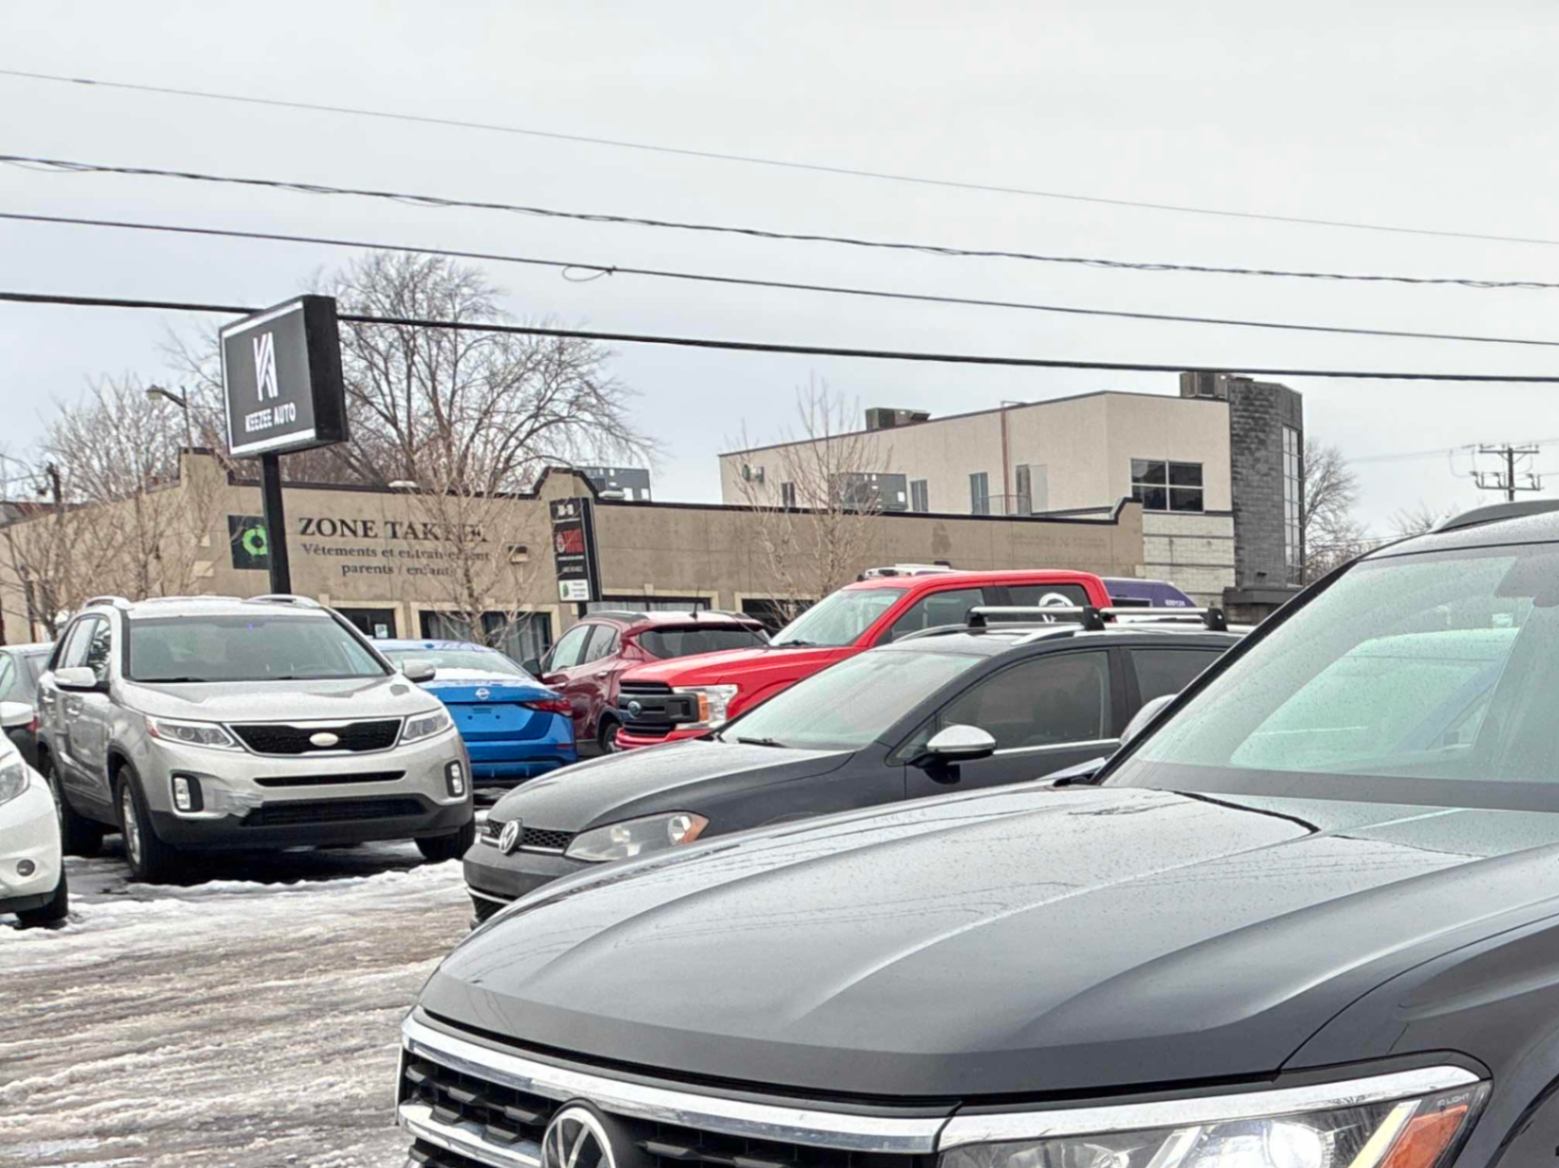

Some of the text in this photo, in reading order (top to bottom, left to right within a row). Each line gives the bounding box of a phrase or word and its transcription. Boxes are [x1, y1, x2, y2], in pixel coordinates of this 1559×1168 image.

[245, 401, 297, 433] KEEZEE AUTO
[298, 517, 379, 539] ZONE
[381, 548, 395, 558] et
[341, 563, 395, 578] parents
